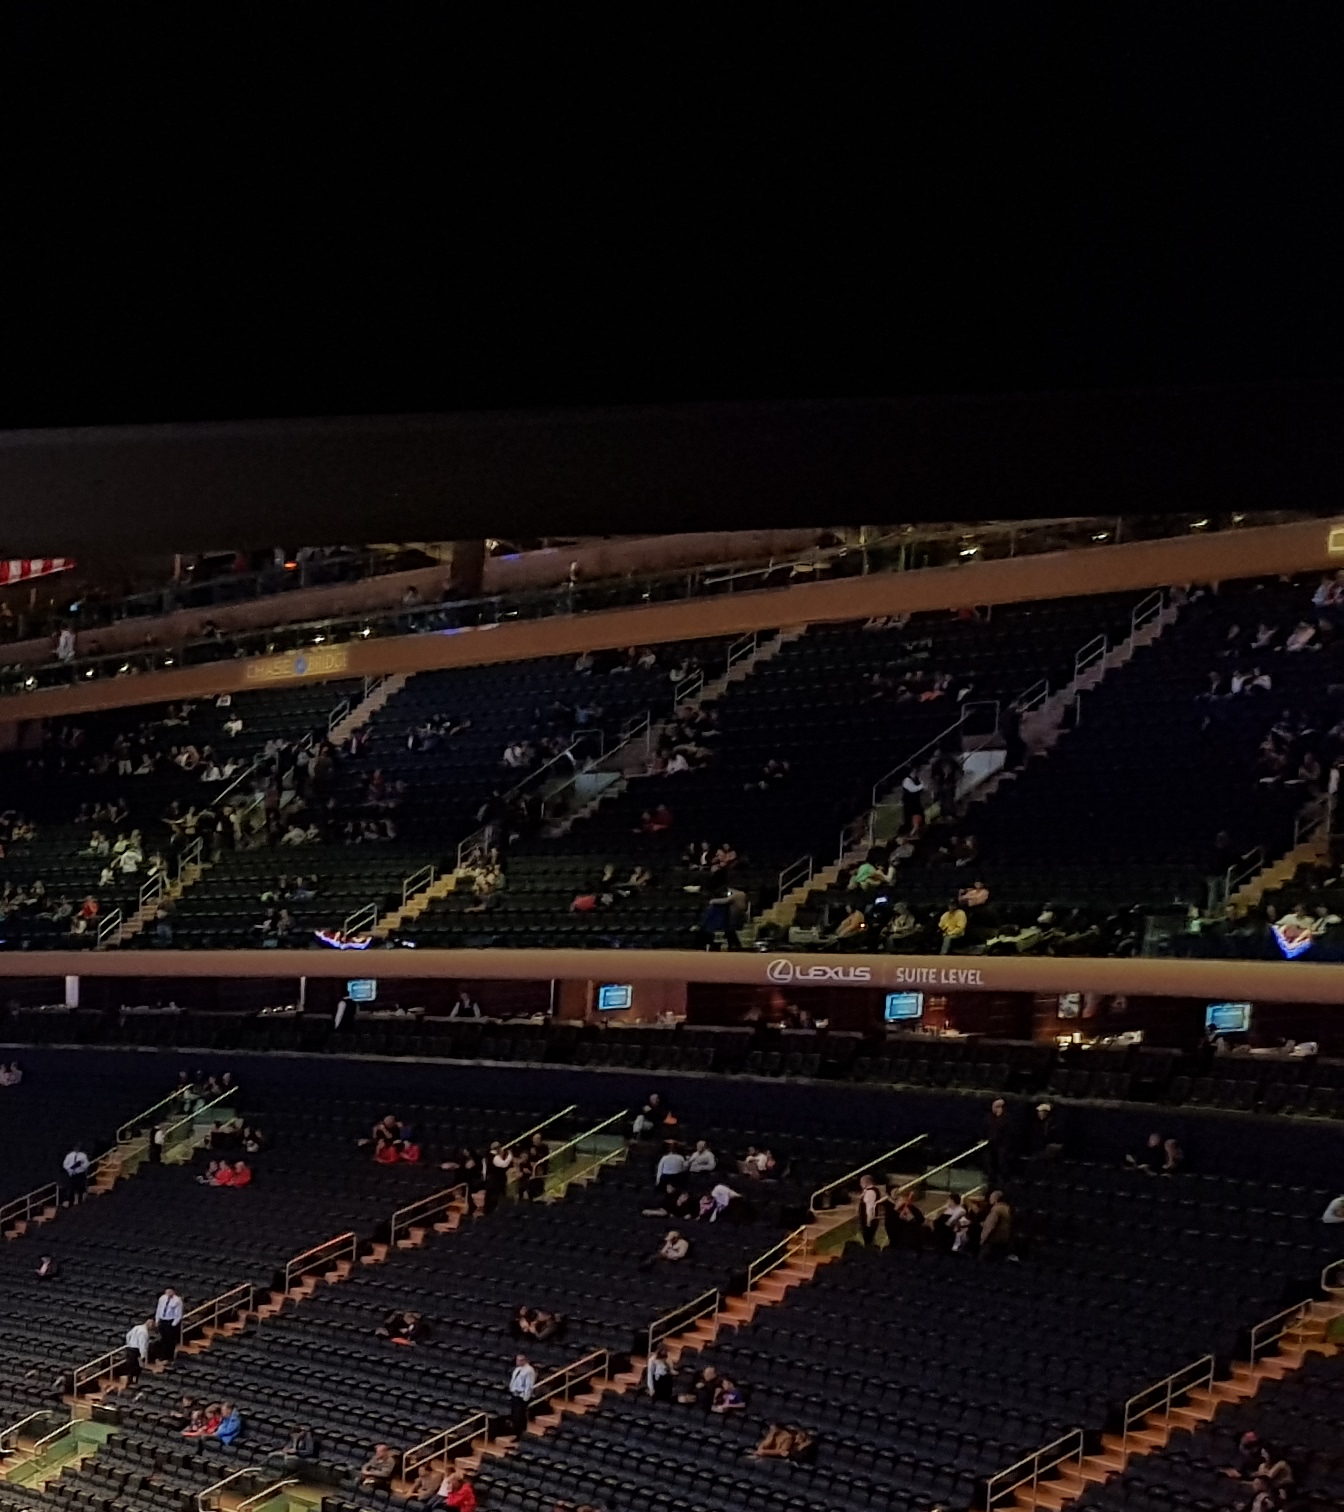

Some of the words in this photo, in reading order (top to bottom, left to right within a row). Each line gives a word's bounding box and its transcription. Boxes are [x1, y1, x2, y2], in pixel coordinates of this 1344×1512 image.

[795, 966, 871, 981] LEXUS
[896, 967, 936, 982] SUITE
[941, 969, 984, 985] LEVEL
